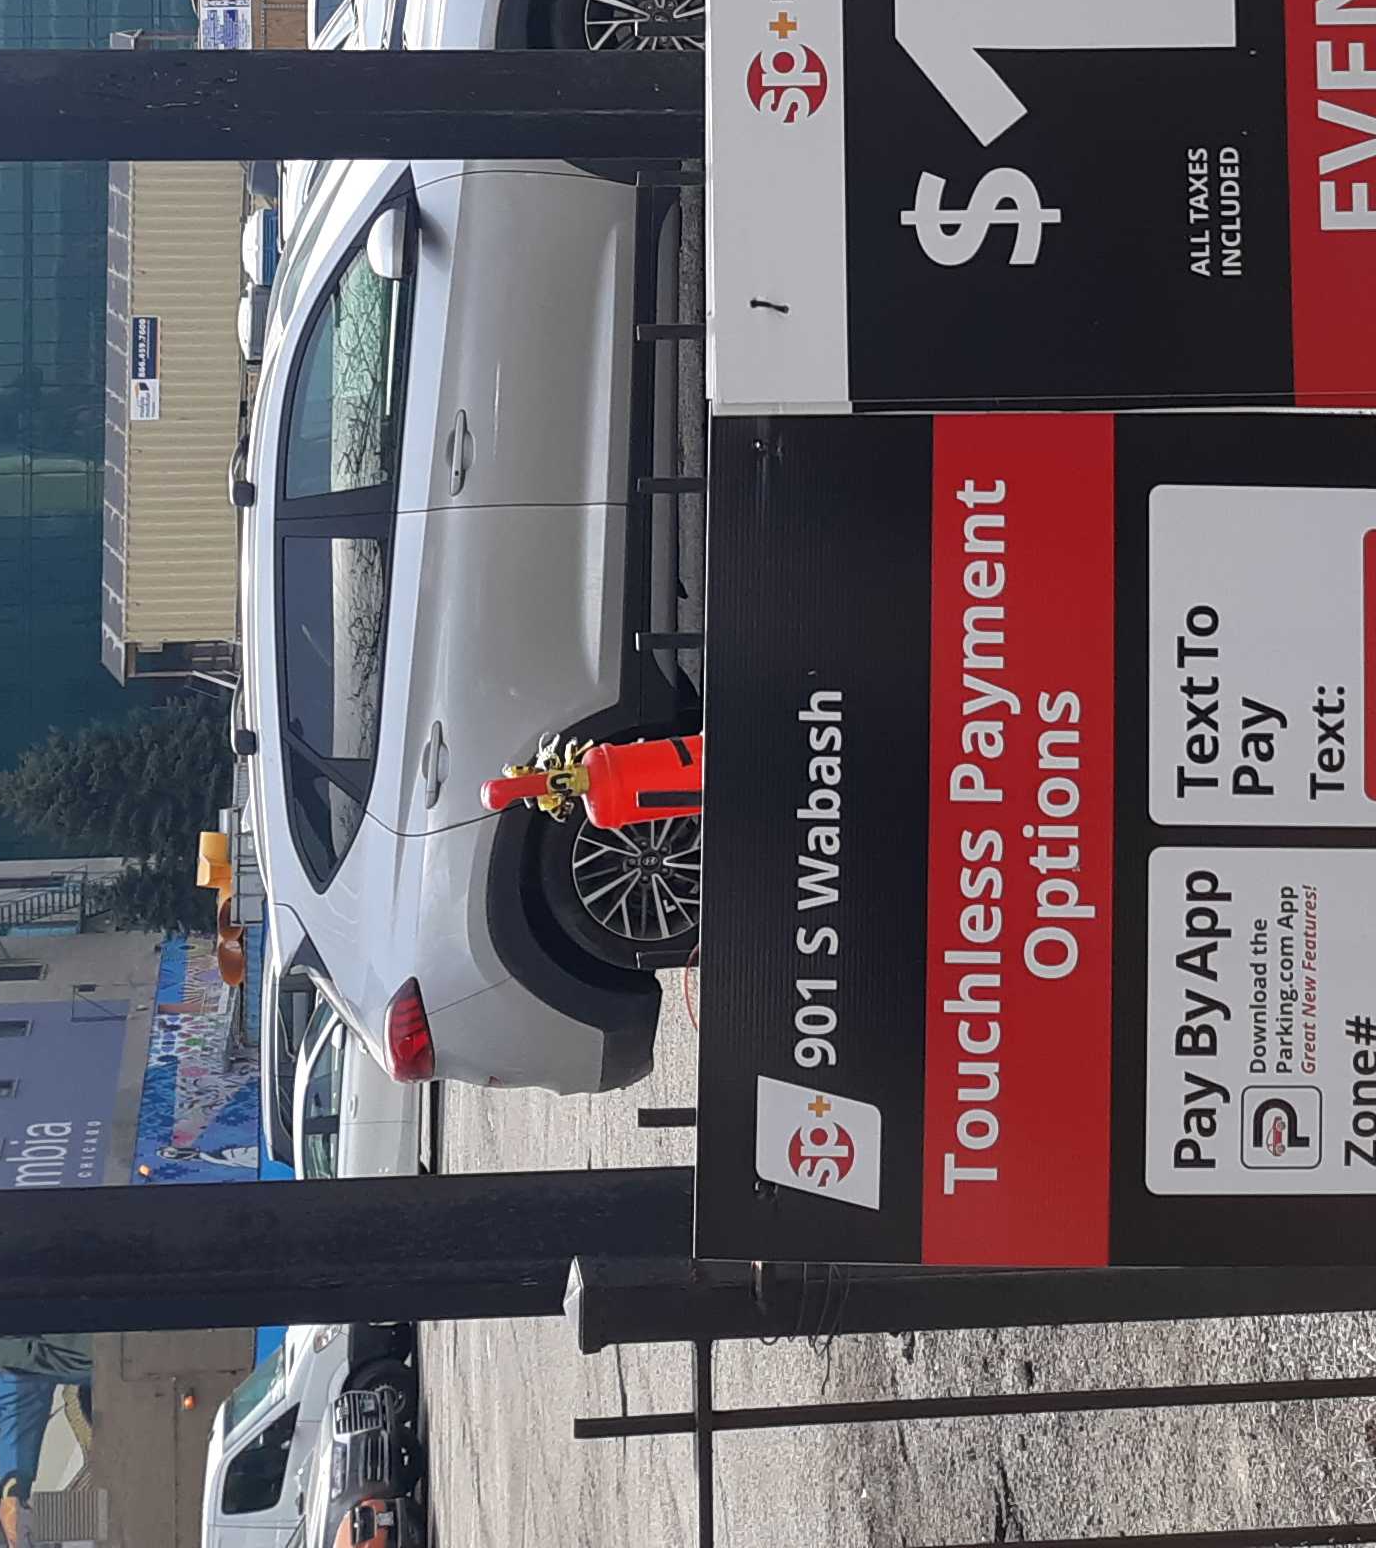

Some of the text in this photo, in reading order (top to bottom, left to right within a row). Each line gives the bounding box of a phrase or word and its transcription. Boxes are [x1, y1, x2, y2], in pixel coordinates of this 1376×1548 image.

[1187, 147, 1211, 277] ALL TAXES
[1219, 147, 1242, 277] INCLUDED
[1177, 605, 1219, 798] Text To
[1232, 697, 1287, 796] Pay
[1310, 685, 1345, 800] Text:
[797, 689, 843, 910] Wabash
[943, 479, 1021, 1195] Touchless Payment
[1022, 689, 1096, 980] Options
[796, 925, 839, 956] S
[1249, 918, 1267, 1074] Download the
[1276, 886, 1298, 1074] Parking.com App
[1301, 884, 1317, 1075] Great New Features!
[794, 978, 838, 1068] 901
[1174, 870, 1232, 1169] Pay By App
[5, 1121, 72, 1187] mbia
[77, 1120, 102, 1178] CHICAGO
